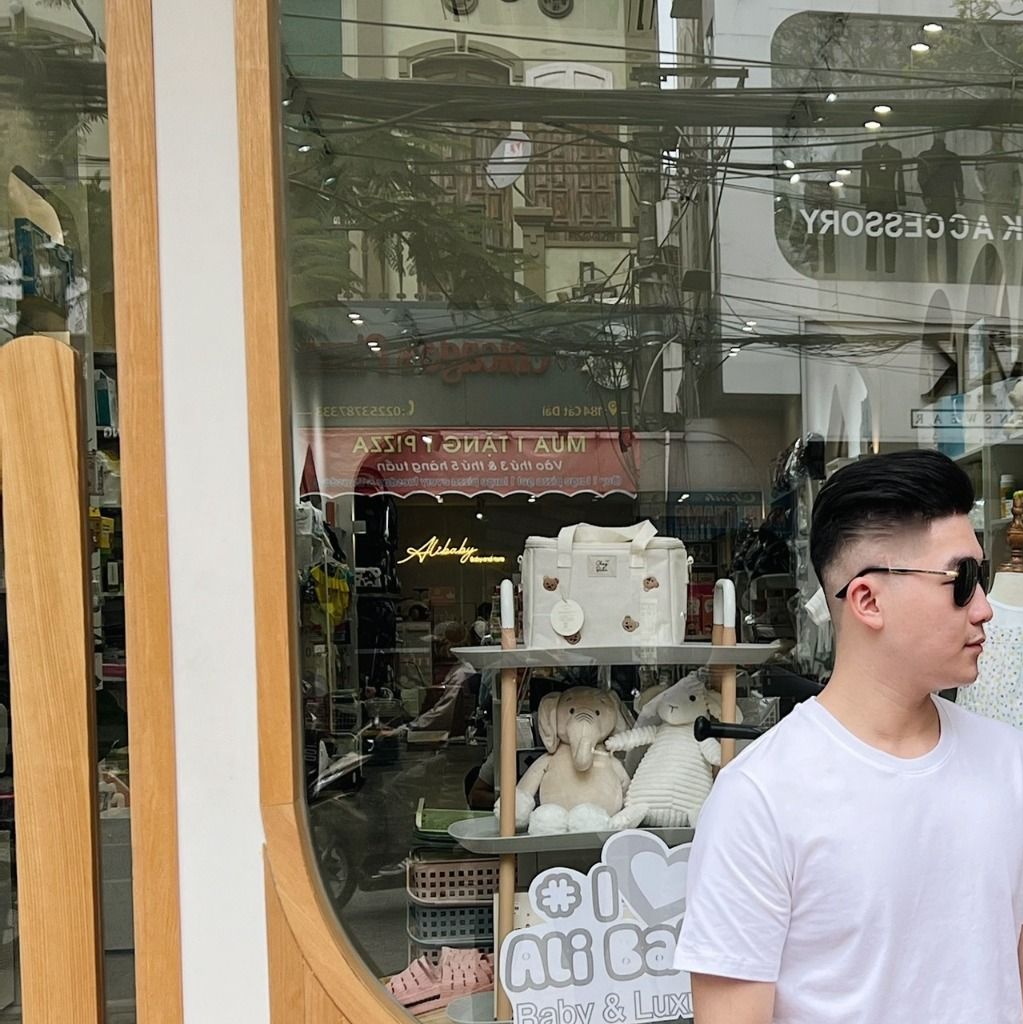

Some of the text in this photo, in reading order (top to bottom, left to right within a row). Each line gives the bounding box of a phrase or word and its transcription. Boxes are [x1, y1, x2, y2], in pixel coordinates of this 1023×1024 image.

[397, 535, 478, 564] Alibaby
[604, 918, 683, 981] Ba
[603, 993, 626, 1023] &
